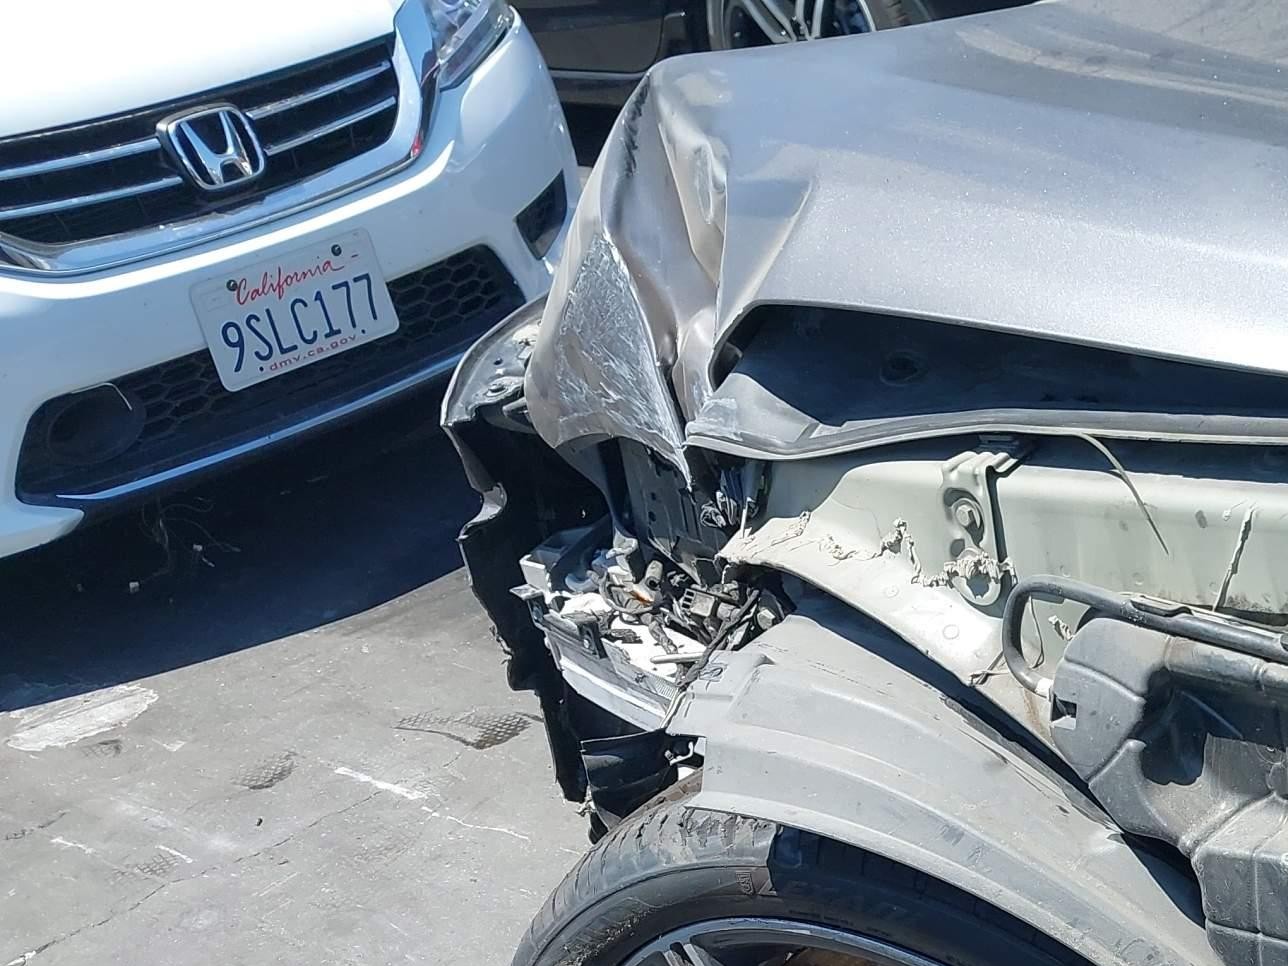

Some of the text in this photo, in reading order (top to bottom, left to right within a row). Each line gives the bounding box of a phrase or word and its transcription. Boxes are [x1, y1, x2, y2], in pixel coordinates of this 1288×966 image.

[235, 256, 345, 305] California
[221, 272, 378, 373] 9SLC177
[269, 334, 356, 372] dmv.ca.gov
